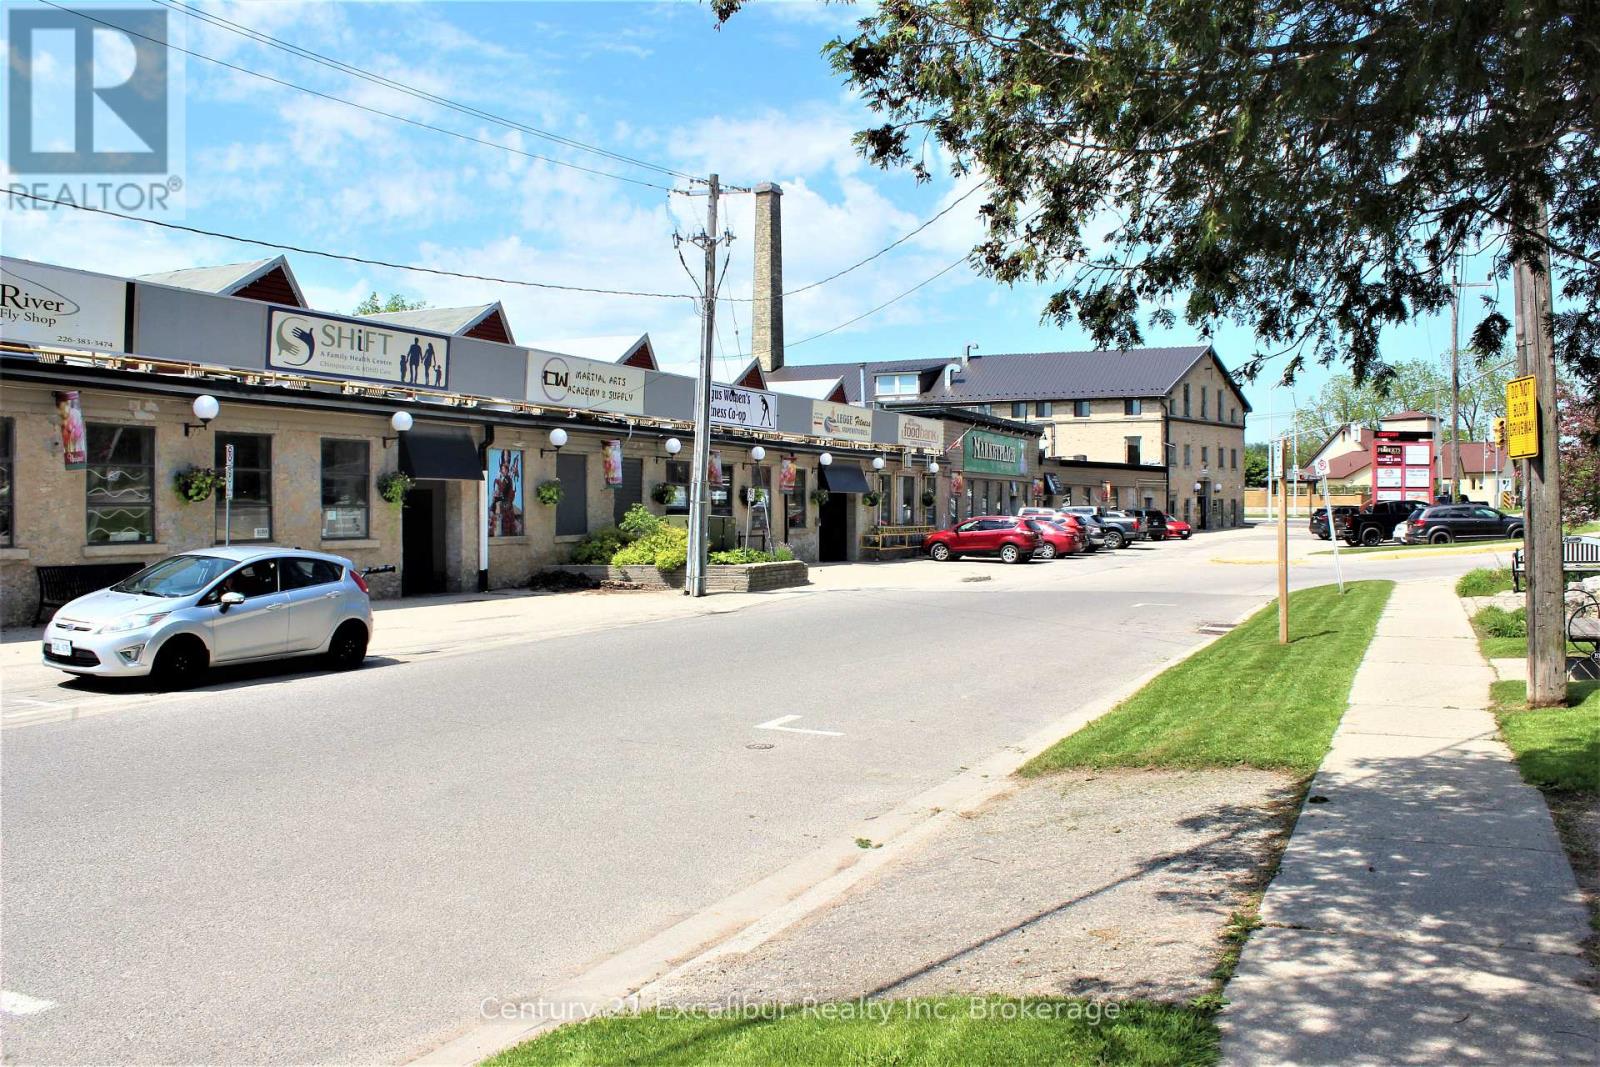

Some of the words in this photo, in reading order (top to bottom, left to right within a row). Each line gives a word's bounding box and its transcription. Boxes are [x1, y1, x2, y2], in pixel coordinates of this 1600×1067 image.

[0, 283, 64, 313] River
[0, 308, 20, 322] Fly
[24, 312, 57, 327] Shop
[321, 324, 393, 355] SHiFT
[327, 351, 348, 361] Family
[350, 354, 370, 364] Health
[576, 371, 606, 384] MARTIAL
[609, 376, 626, 387] ARTS
[567, 385, 600, 398] ACADEMY
[609, 390, 633, 402] SUPPLY
[1520, 381, 1530, 397] NOT
[728, 407, 747, 424] Co-op
[1509, 420, 1534, 437] DRIVEWAY
